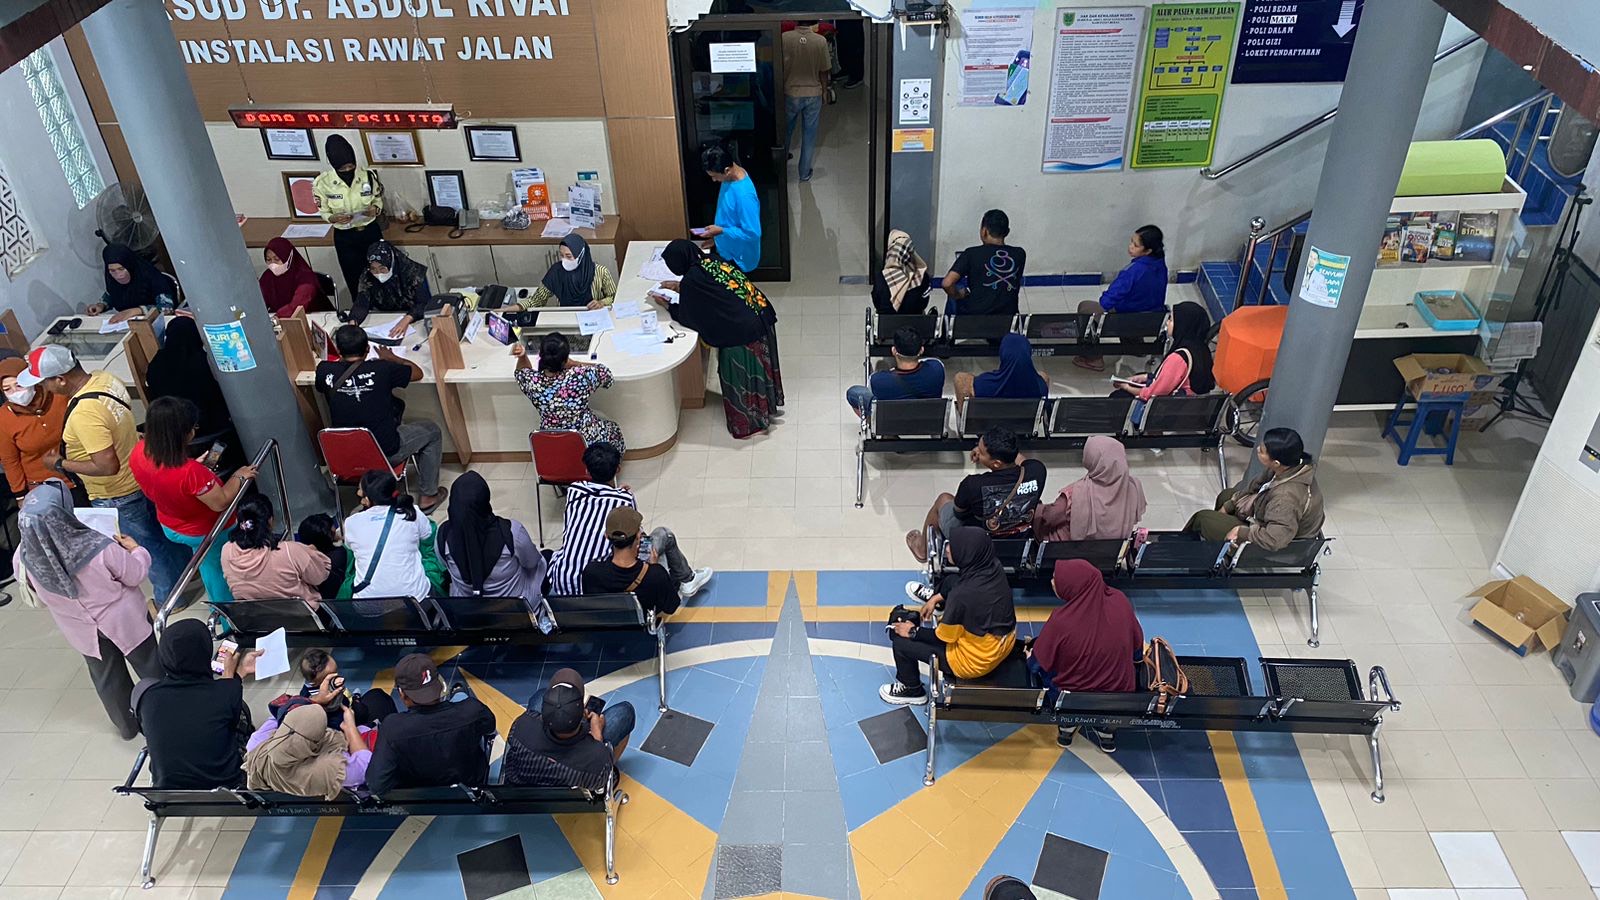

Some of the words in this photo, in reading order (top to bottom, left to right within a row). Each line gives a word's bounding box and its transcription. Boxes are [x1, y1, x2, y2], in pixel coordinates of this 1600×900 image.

[327, 0, 454, 19] ABDUL
[1253, 5, 1271, 13] POLI
[1272, 4, 1297, 13] BEDAH
[1251, 16, 1269, 24] POLI
[1270, 15, 1296, 24] MATA
[1249, 27, 1267, 35] POLI
[1268, 26, 1294, 34] DALAM
[1247, 38, 1265, 46] POLI
[1265, 38, 1282, 46] GIZI
[179, 38, 336, 64] INSTALASI
[342, 37, 446, 62] RAWAT
[457, 36, 554, 61] JALAN
[1245, 49, 1269, 57] LOKET
[1269, 48, 1321, 57] PENDAFTARAN
